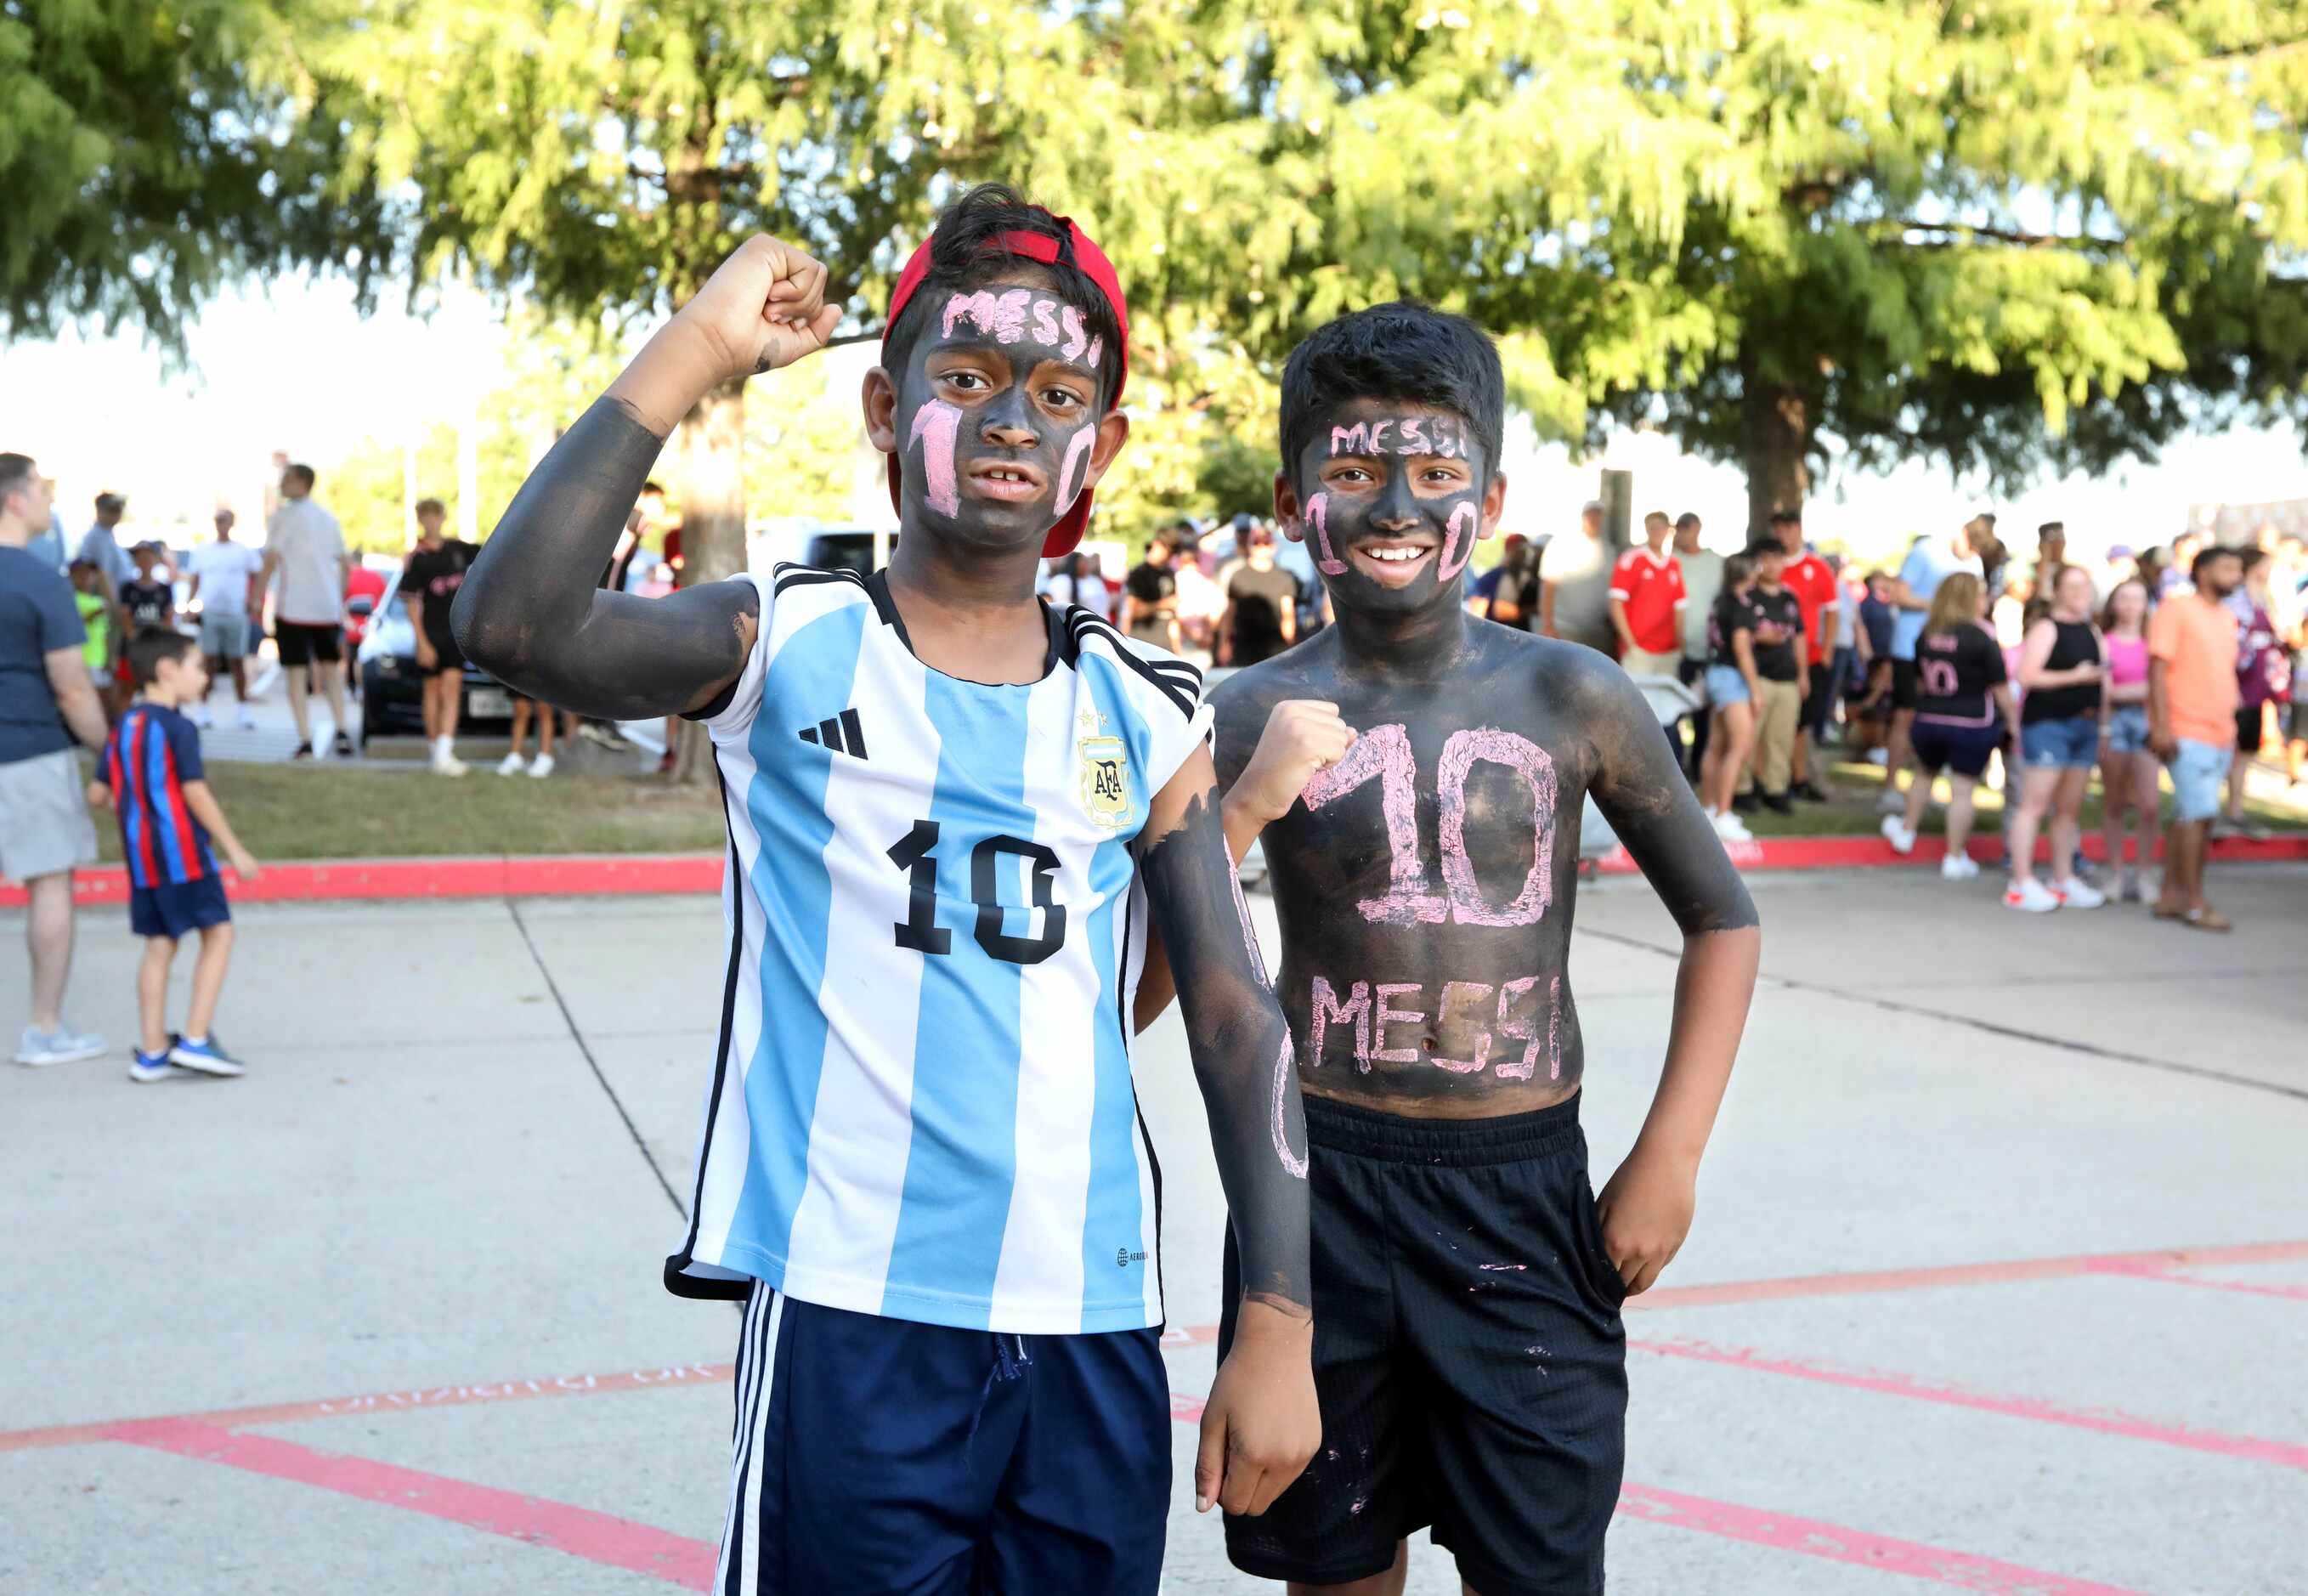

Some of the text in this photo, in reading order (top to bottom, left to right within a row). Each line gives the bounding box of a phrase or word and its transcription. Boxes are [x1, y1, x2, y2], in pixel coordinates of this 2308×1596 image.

[1331, 419, 1468, 457] MESSI
[1095, 761, 1122, 801] AFA
[1300, 723, 1557, 927] 10
[886, 820, 1066, 965] 10
[1311, 975, 1560, 1080] MESSI
